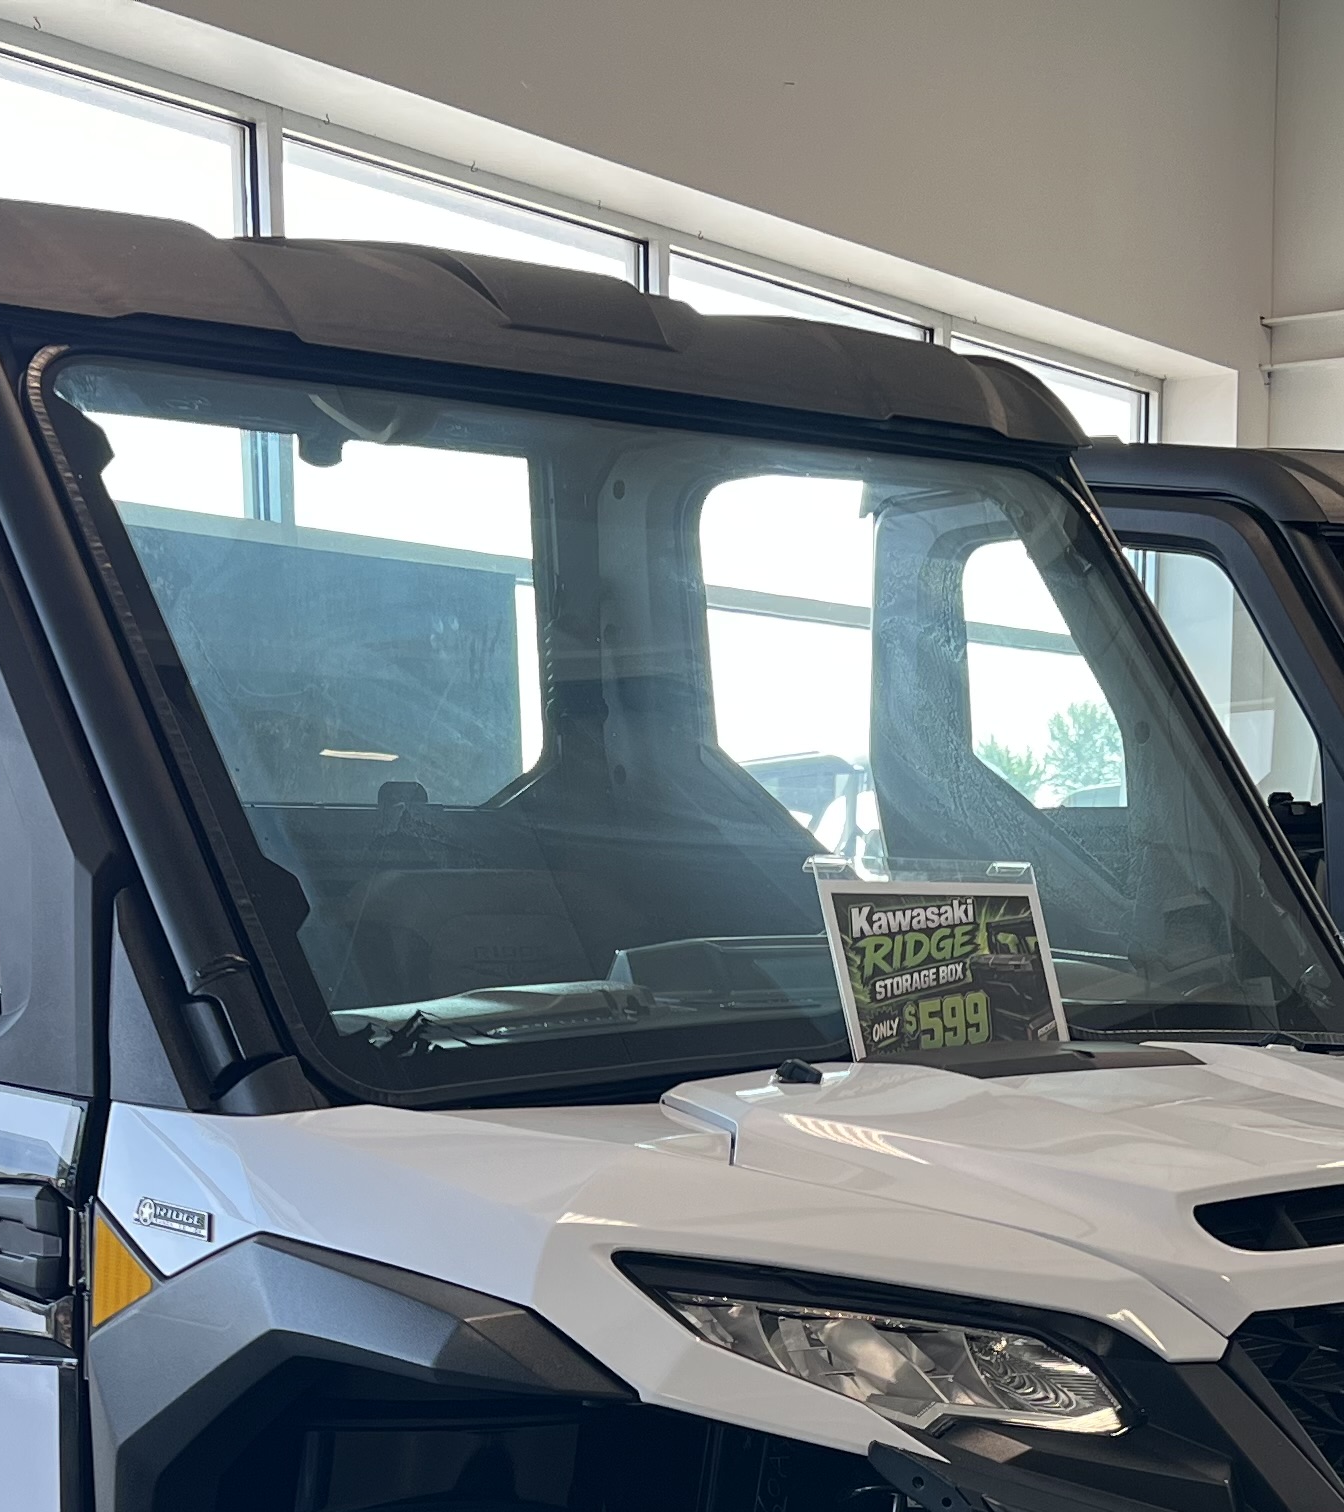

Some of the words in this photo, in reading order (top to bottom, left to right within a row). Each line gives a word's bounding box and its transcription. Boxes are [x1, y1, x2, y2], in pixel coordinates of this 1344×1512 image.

[851, 899, 975, 938] Kawasaki
[854, 925, 976, 978] RIDGE
[875, 967, 937, 1001] STORAGE
[939, 962, 964, 984] BOX
[872, 1016, 899, 1042] ONLY
[903, 991, 989, 1049] $599
